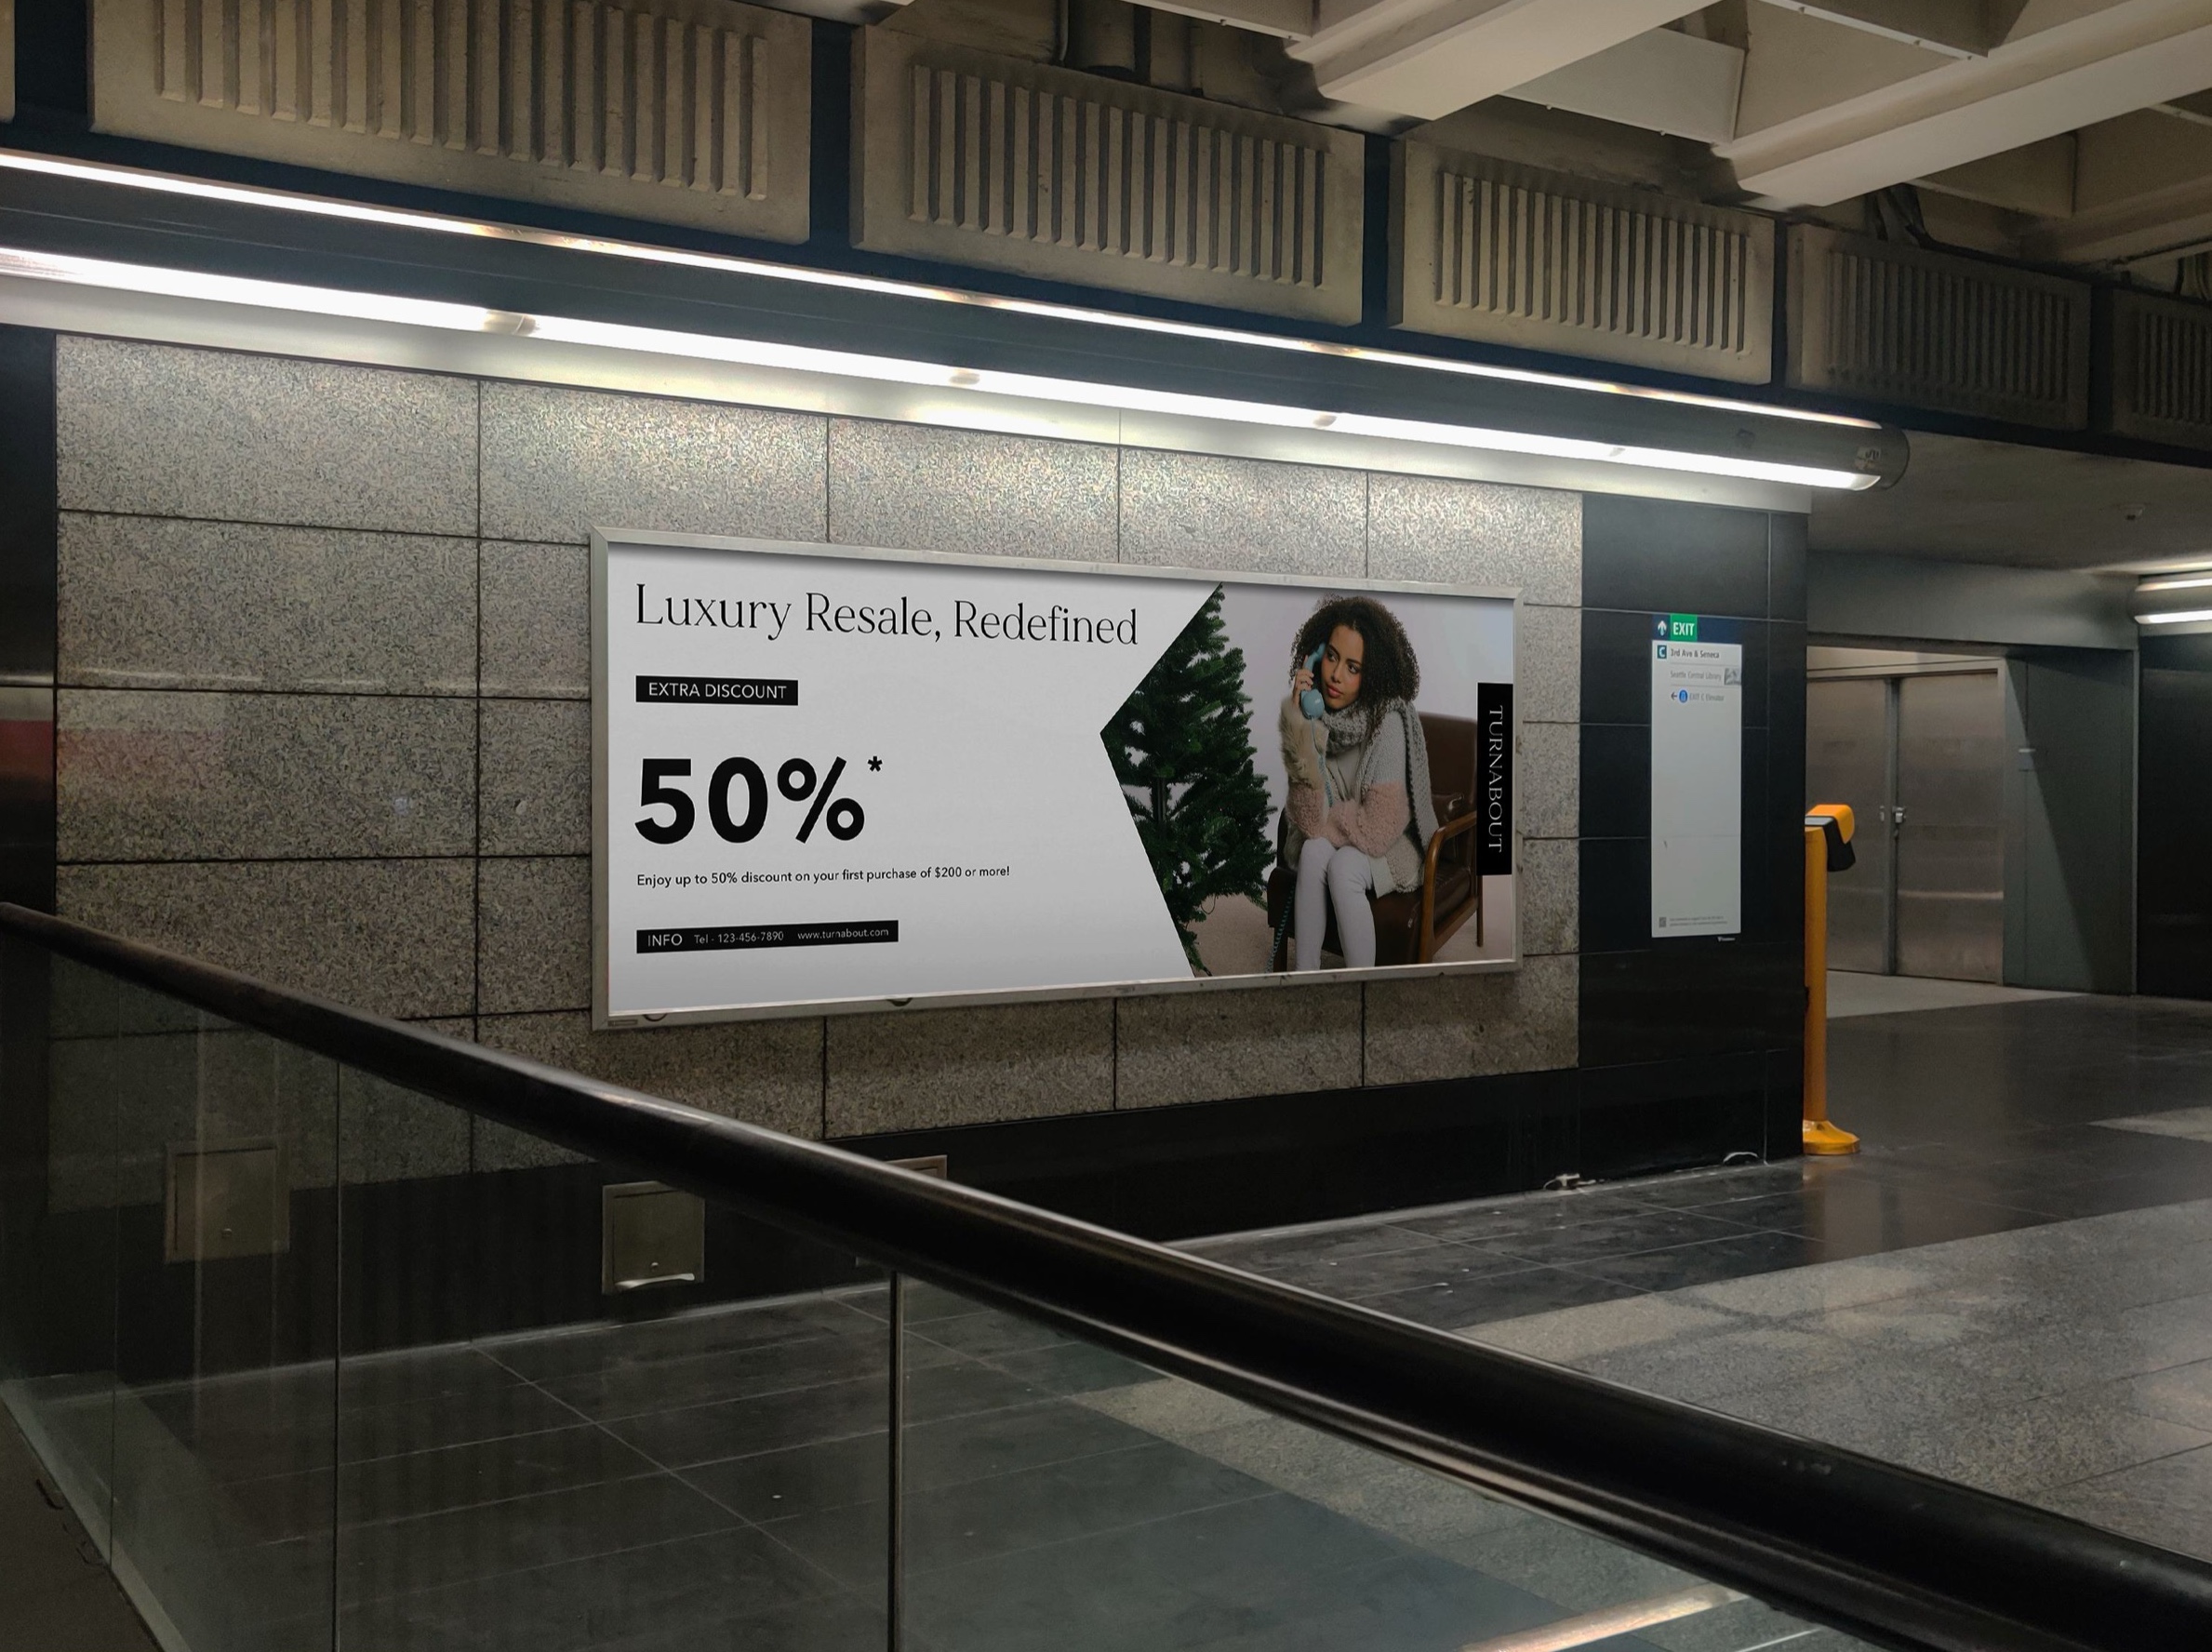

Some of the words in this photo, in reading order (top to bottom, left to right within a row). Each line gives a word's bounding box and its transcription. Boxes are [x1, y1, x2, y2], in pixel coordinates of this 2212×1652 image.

[636, 583, 792, 641] Luxury
[806, 592, 941, 642] Resale,
[953, 600, 1139, 646] Redefined
[1672, 621, 1695, 636] EXIT
[1659, 646, 1666, 658] C
[1671, 647, 1681, 657] 3rd
[1682, 648, 1693, 658] Ave
[1694, 649, 1699, 659] &
[1699, 649, 1720, 659] Seneca
[1670, 670, 1686, 679] Seattle
[647, 682, 701, 699] EXTRA
[704, 683, 787, 699] DISCOUNT
[1488, 704, 1503, 853] TURNABOUT
[637, 873, 672, 889] Enjoy
[674, 875, 692, 888] up
[694, 873, 708, 885] to
[711, 872, 738, 885] 50%
[740, 871, 793, 884] discount
[794, 873, 810, 882] on
[813, 872, 839, 884] your
[841, 868, 864, 882] first
[866, 867, 917, 882] purchase
[920, 866, 932, 878] of
[934, 866, 963, 879] $200
[965, 868, 977, 877] or
[979, 865, 1010, 878] more!
[647, 933, 683, 947] INFO
[693, 933, 709, 944] Tel
[717, 930, 784, 944] 123-456-7890
[797, 927, 889, 940] www.turnabout.com
